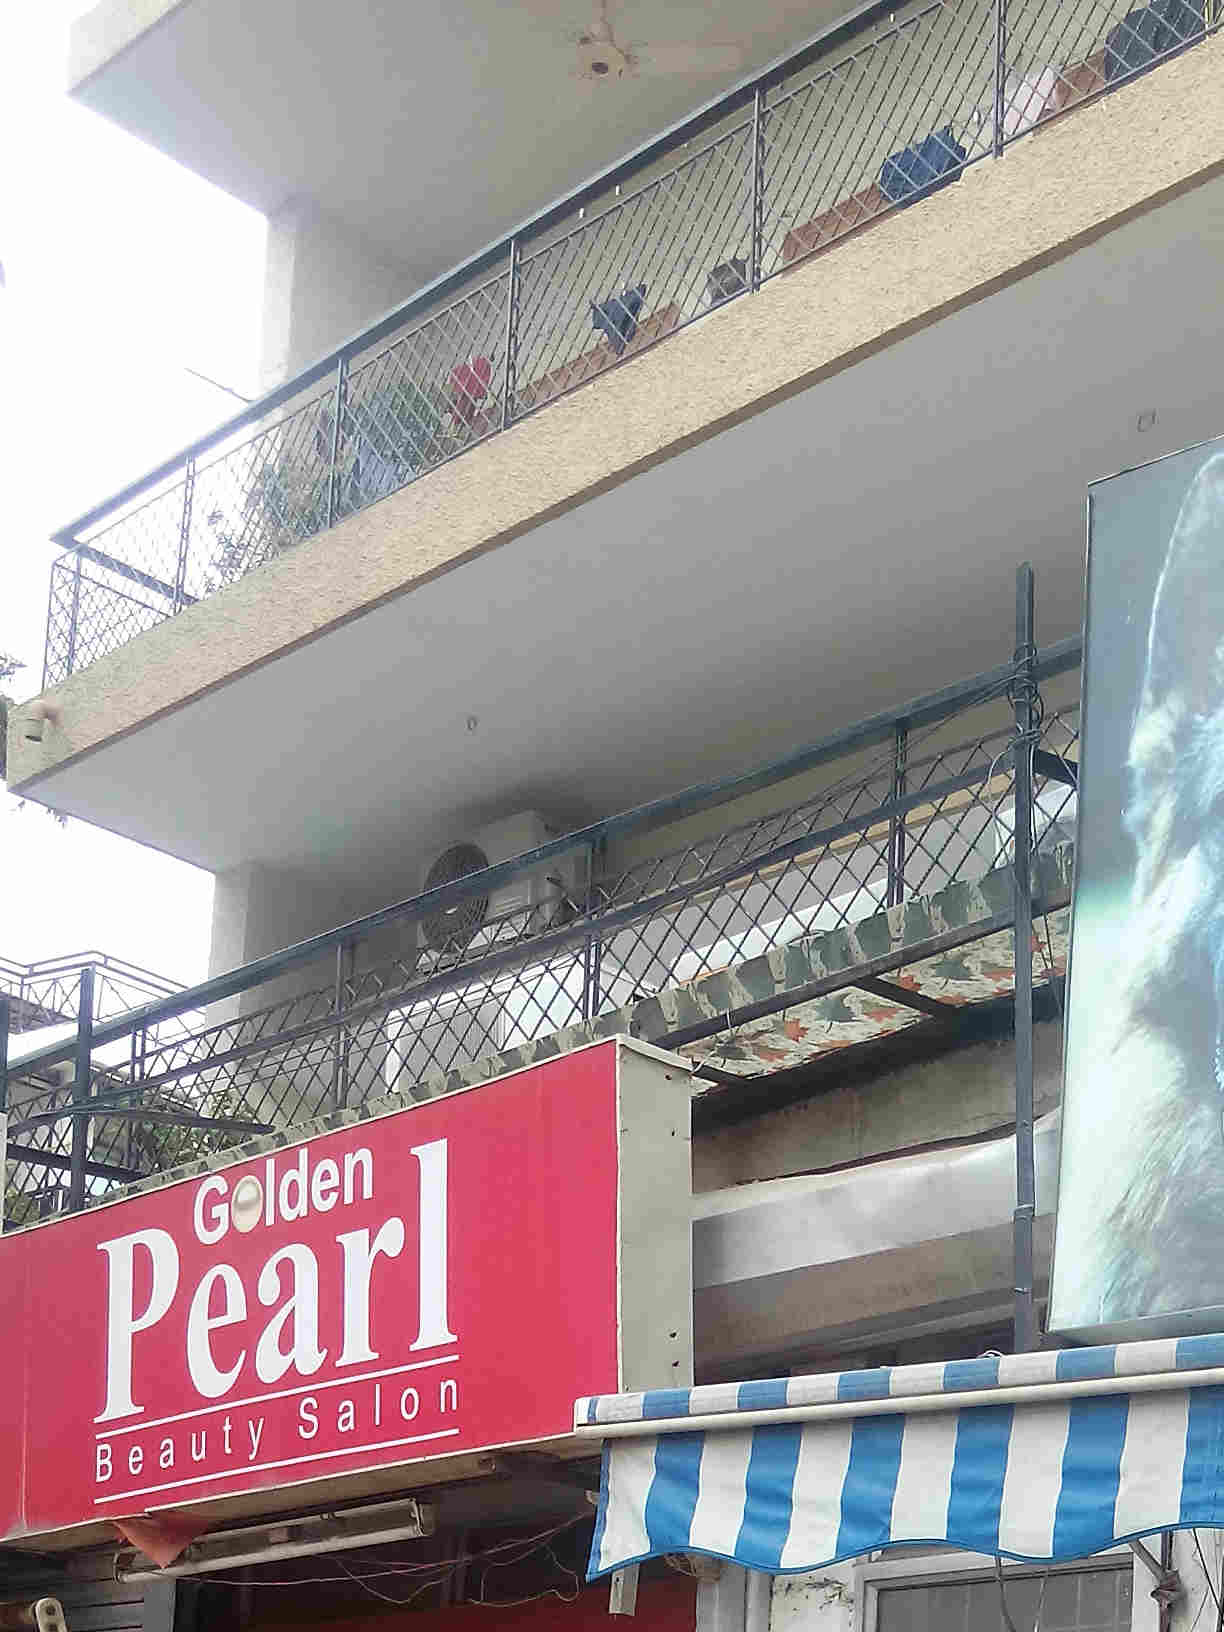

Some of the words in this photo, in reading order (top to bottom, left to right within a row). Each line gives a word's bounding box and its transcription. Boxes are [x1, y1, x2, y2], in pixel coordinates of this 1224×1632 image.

[194, 1146, 374, 1245] Golden
[93, 1138, 458, 1424] Pearl
[95, 1413, 265, 1484] Beauty
[298, 1376, 458, 1440] Salon
